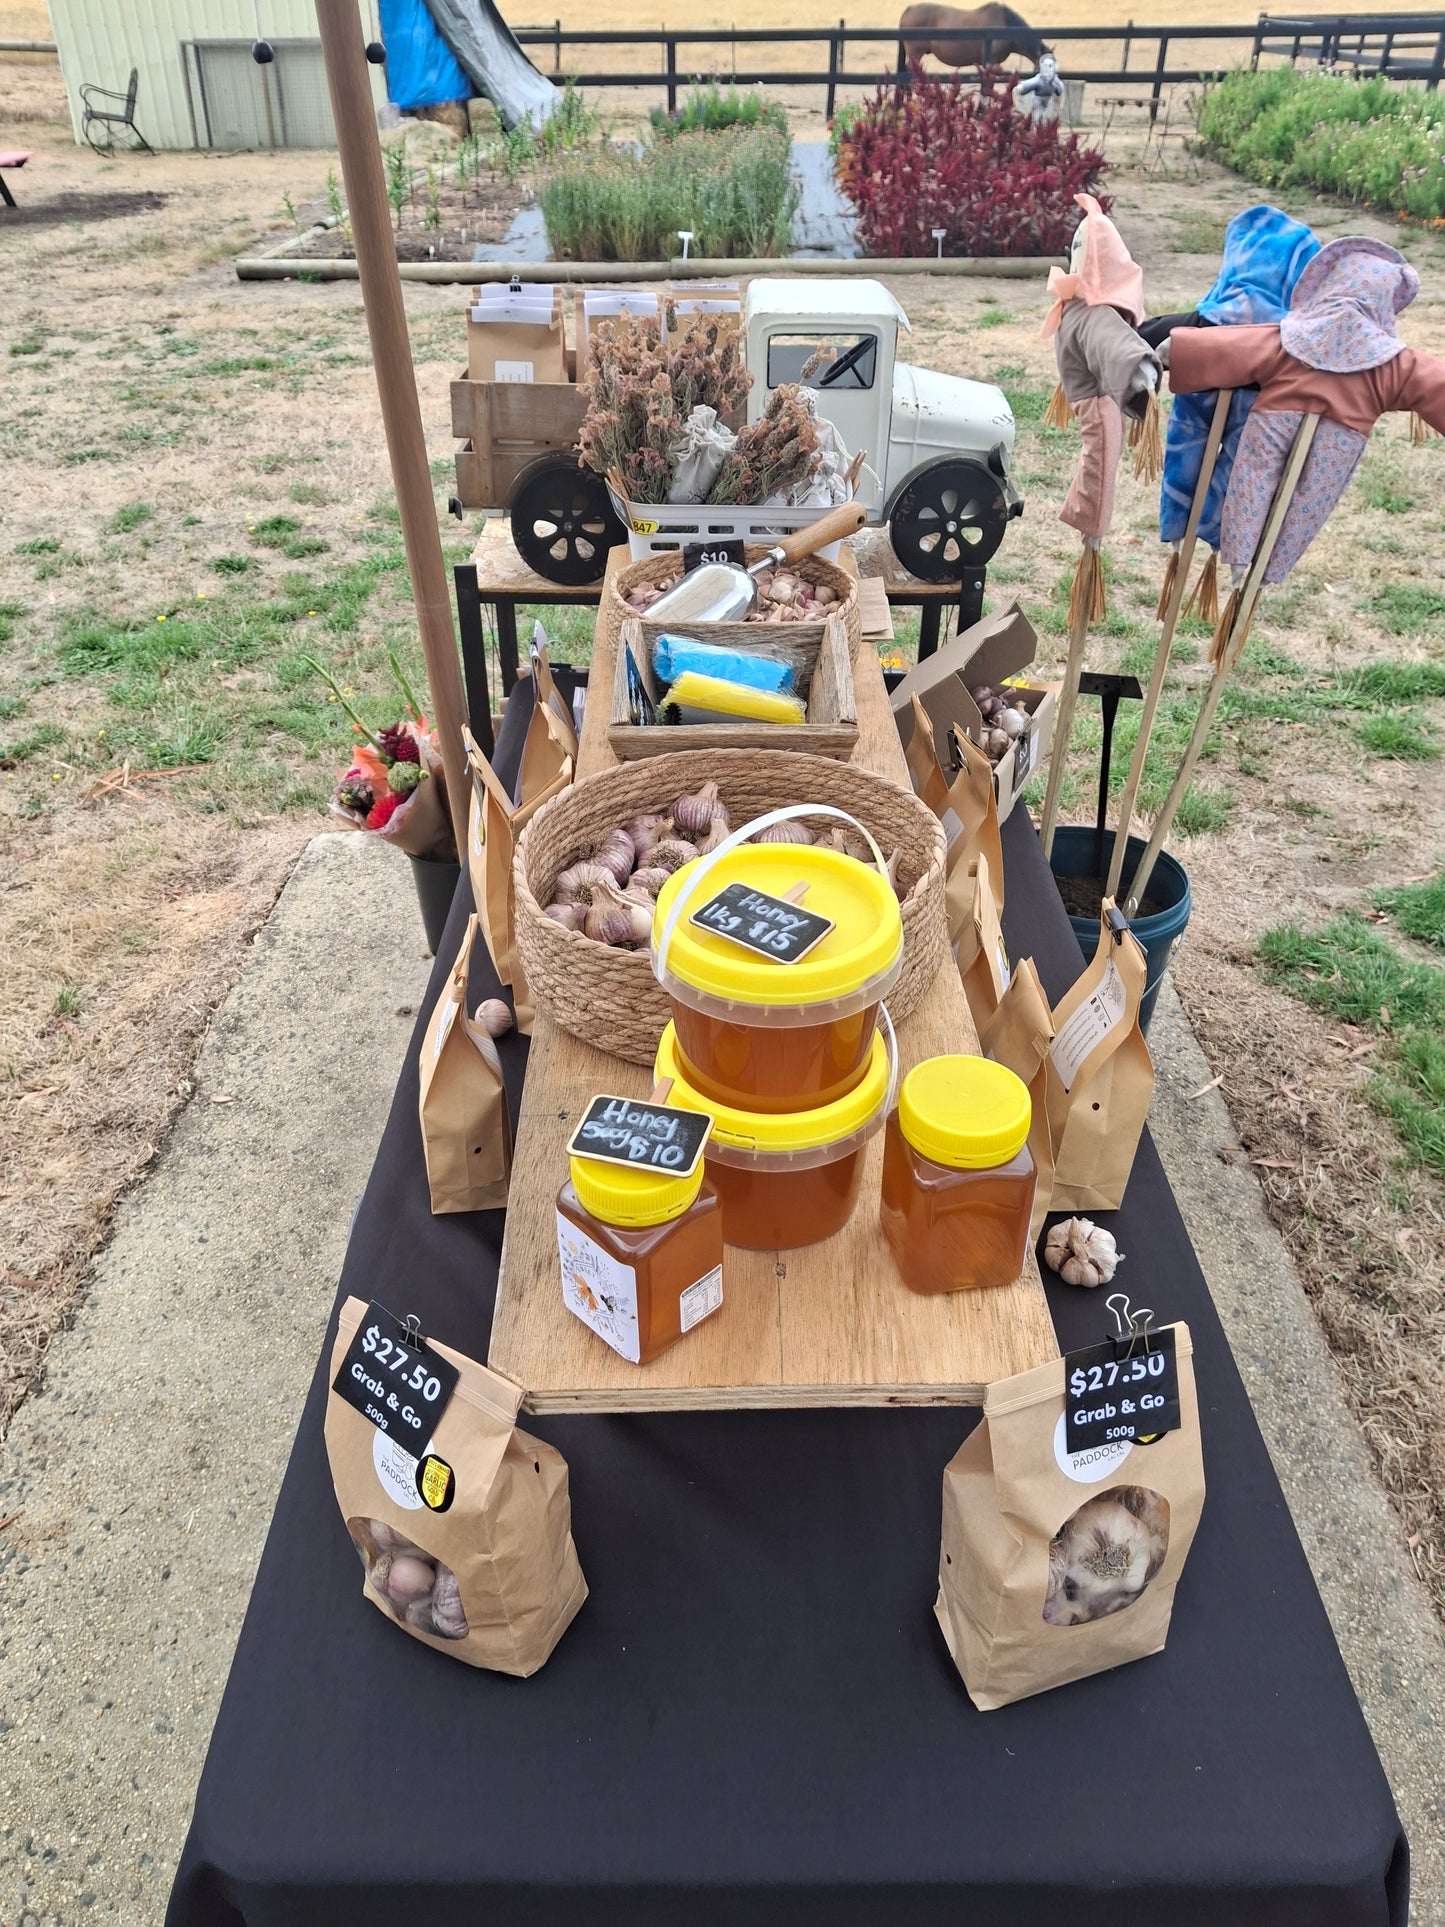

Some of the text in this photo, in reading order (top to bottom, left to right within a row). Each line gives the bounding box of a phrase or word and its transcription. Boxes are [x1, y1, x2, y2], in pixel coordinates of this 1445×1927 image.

[703, 903, 798, 951] 1kg $15
[737, 893, 810, 932] Honey
[602, 1100, 680, 1142] Honey
[629, 1136, 685, 1166] $10
[361, 1324, 442, 1402] $27.50
[1070, 1354, 1165, 1398] $27.50
[351, 1363, 422, 1429] Grab & Go
[1073, 1394, 1165, 1425] Grab & Go
[364, 1403, 389, 1430] 500g
[1106, 1425, 1135, 1439] 500g
[1073, 1441, 1123, 1470] PADDOCK
[381, 1460, 418, 1500] PADDOCK
[425, 1472, 446, 1491] GARLIC
